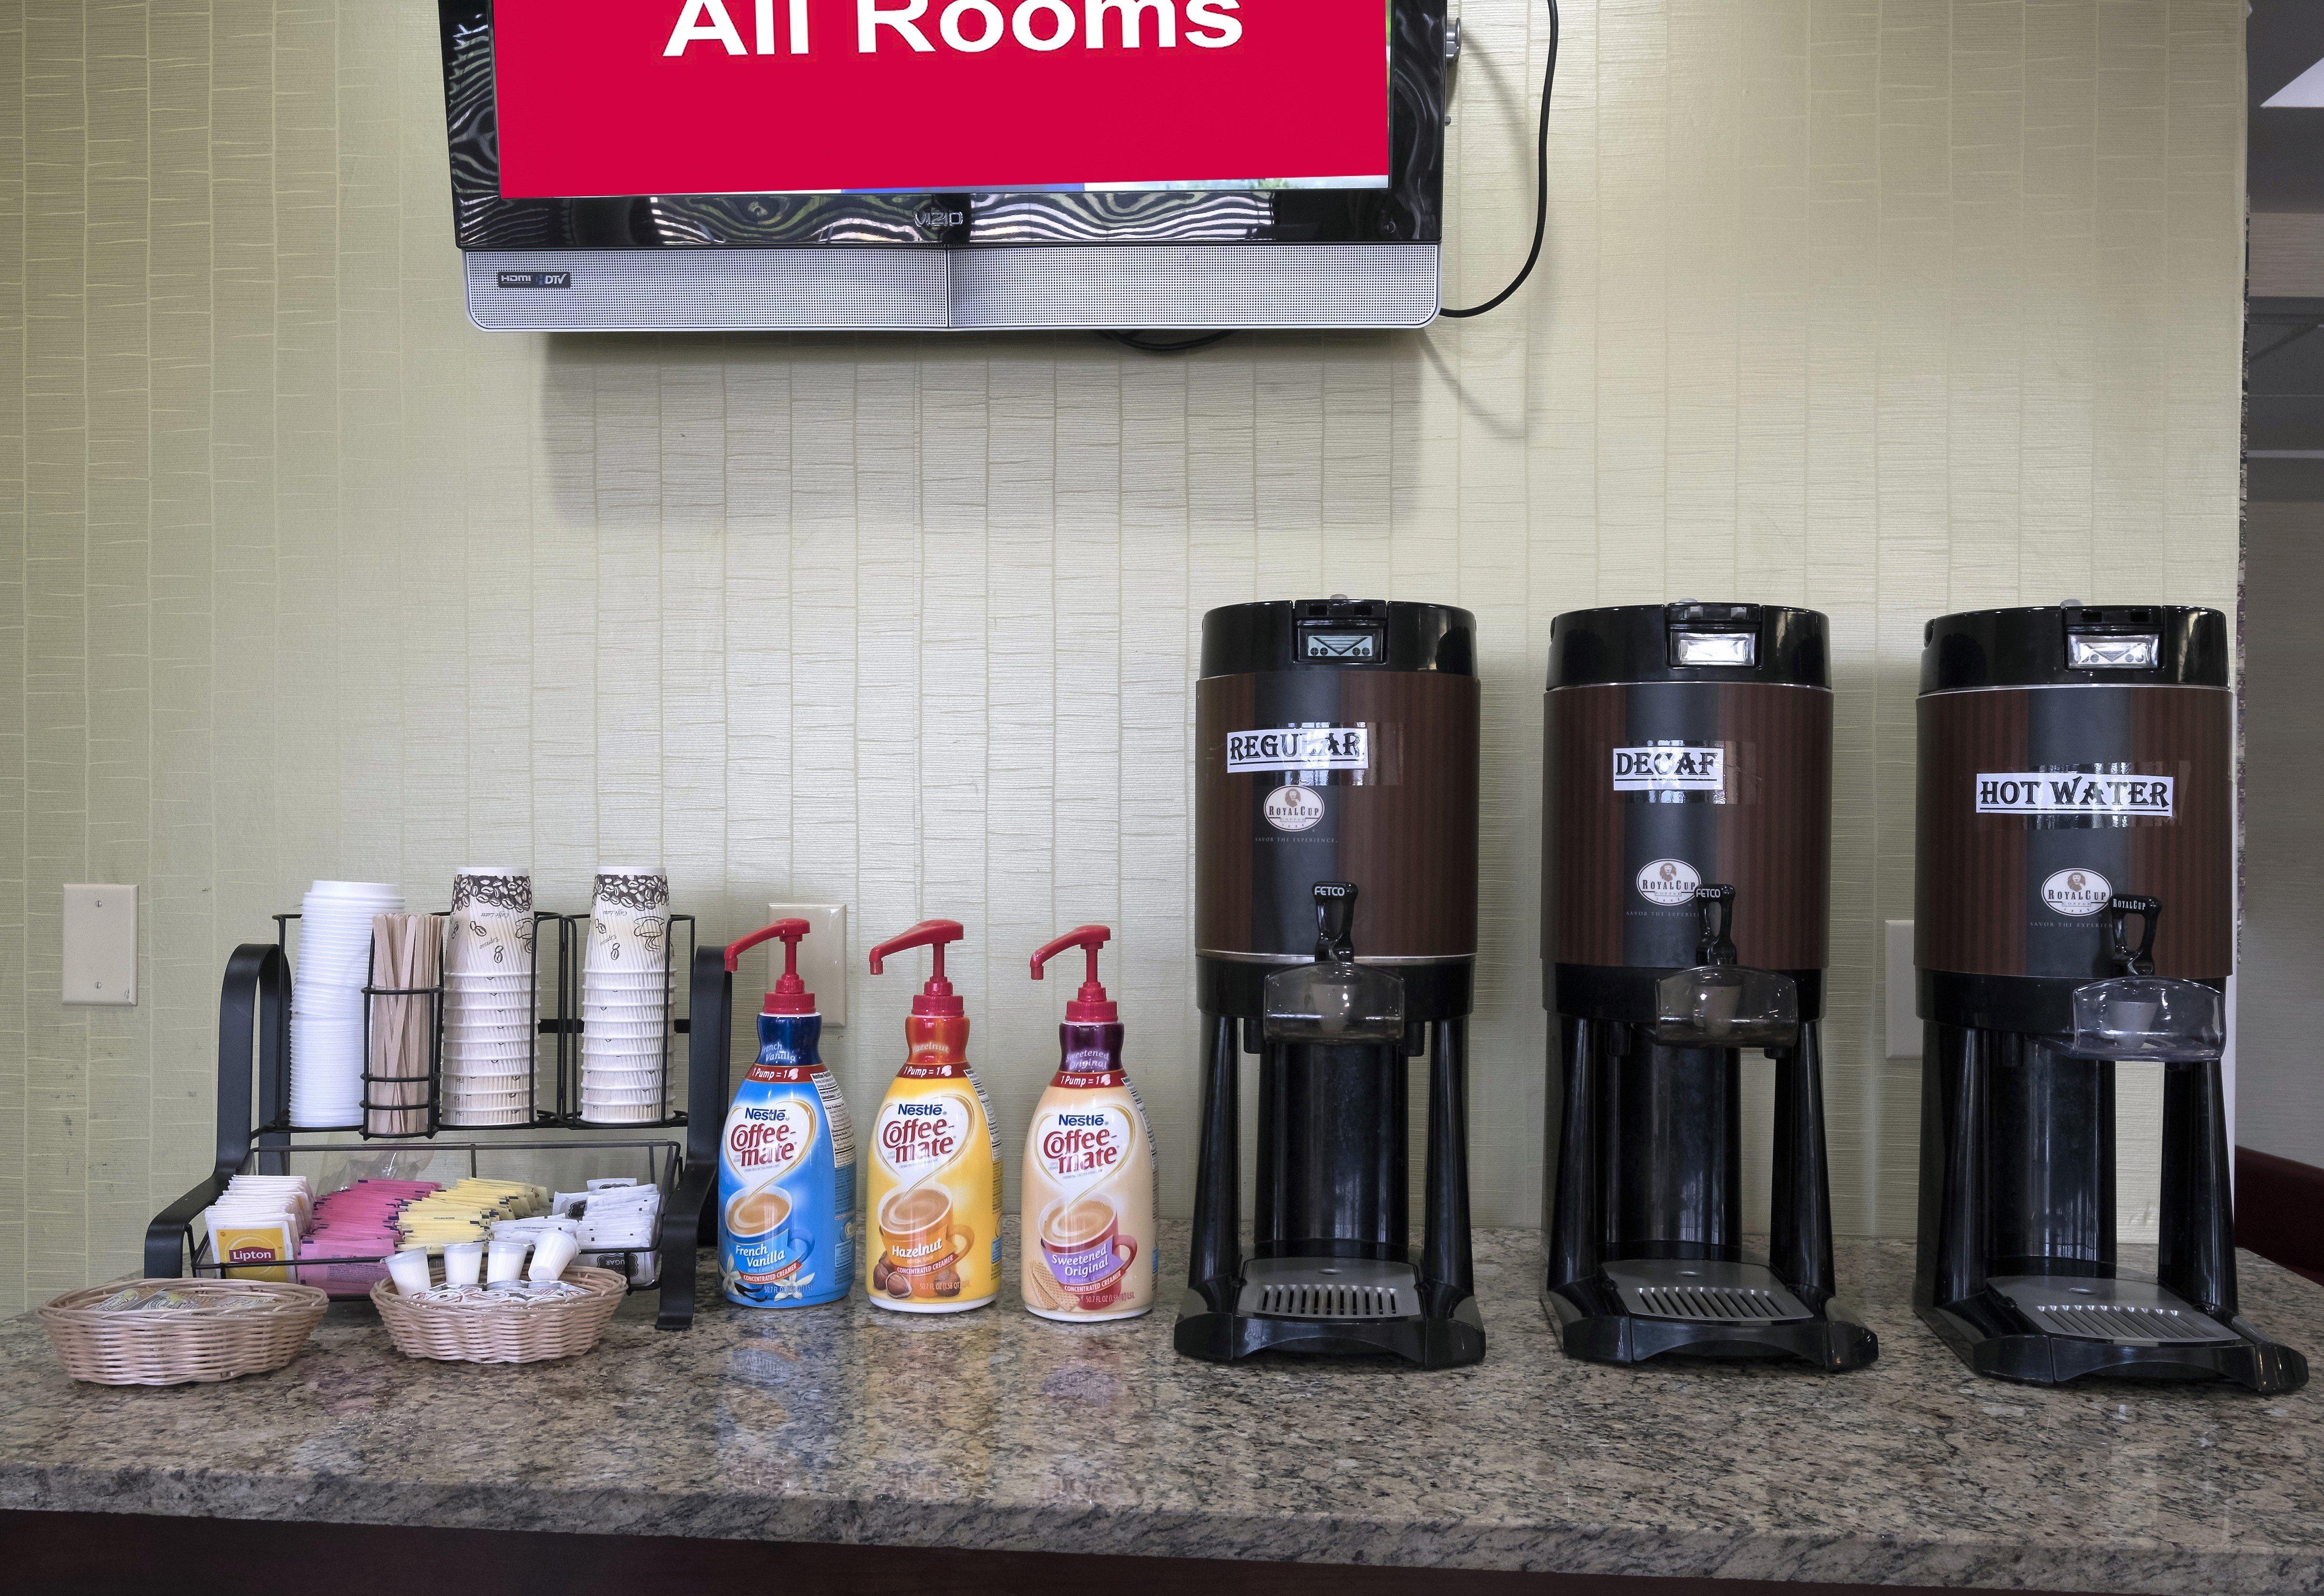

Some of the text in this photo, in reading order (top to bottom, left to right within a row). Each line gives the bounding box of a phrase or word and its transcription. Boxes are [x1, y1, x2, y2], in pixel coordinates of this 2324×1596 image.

[663, 0, 1242, 57] All Rooms
[1616, 752, 1719, 776] DECAF
[1980, 776, 2170, 808] HOT WATER
[1314, 886, 1345, 896] FETCO
[1696, 888, 1720, 898] FETCO
[912, 1042, 949, 1054] Hazelnut
[756, 1068, 775, 1081] Pump
[907, 1066, 927, 1077] Pump
[1065, 1075, 1087, 1087] Pump
[741, 1143, 794, 1166] mate
[895, 1137, 953, 1163] mate
[1058, 1146, 1117, 1174] mate
[233, 1251, 271, 1261] Lipton
[736, 1243, 768, 1256] French
[892, 1237, 942, 1258] Hazelnut
[1052, 1243, 1107, 1266] Sweetened
[746, 1249, 785, 1268] Vanilla
[897, 1254, 954, 1274] CONCENTRATED CREAMER
[1064, 1254, 1109, 1278] Original
[776, 1263, 797, 1279] CREAMER
[1064, 1270, 1121, 1292] CONCENTRATED CREAMER
